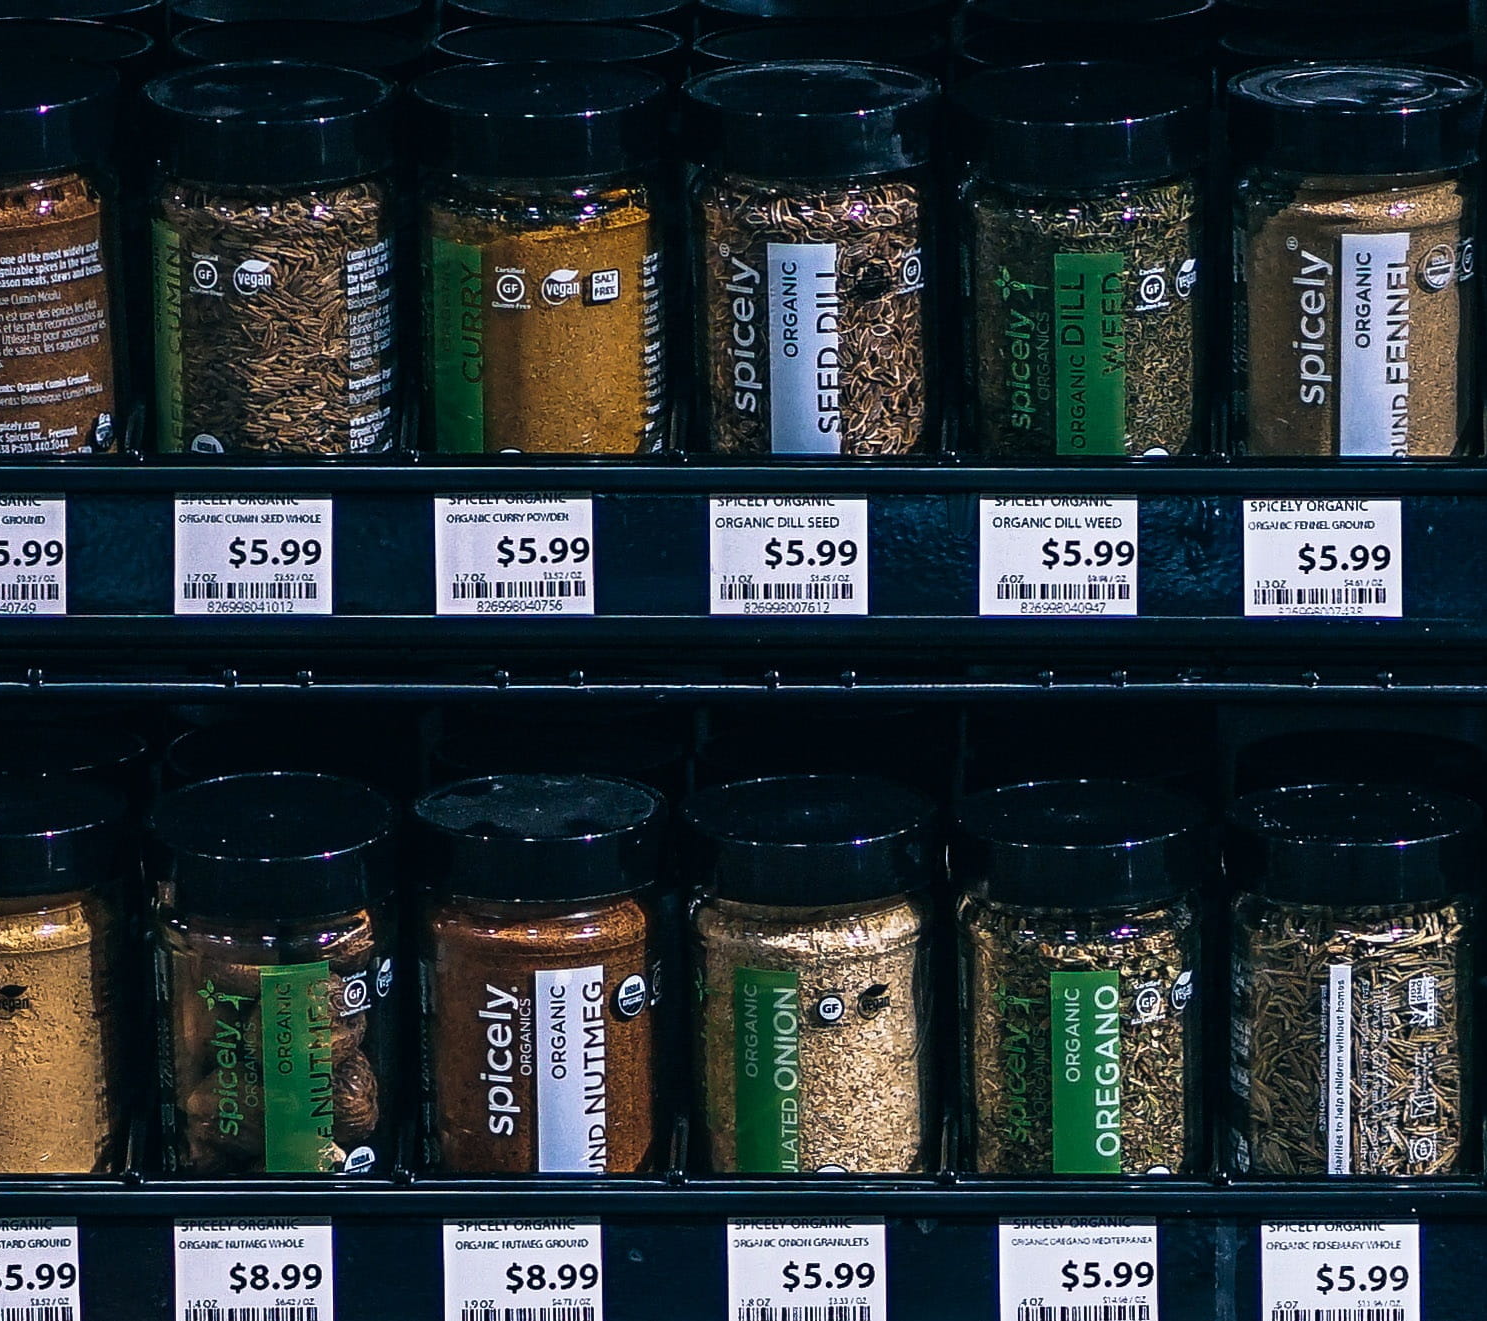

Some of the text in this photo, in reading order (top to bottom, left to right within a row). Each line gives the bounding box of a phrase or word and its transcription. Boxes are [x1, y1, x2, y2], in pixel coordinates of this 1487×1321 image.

[732, 256, 764, 414] spicely
[783, 260, 798, 359] ORGANIC
[1299, 250, 1333, 405] spicely
[765, 538, 857, 569] $5.99
[584, 981, 605, 1112] NUTMEG
[1065, 986, 1082, 1083] ORGANIC
[1095, 983, 1121, 1159] OREGANO
[230, 1263, 322, 1294] $8.99
